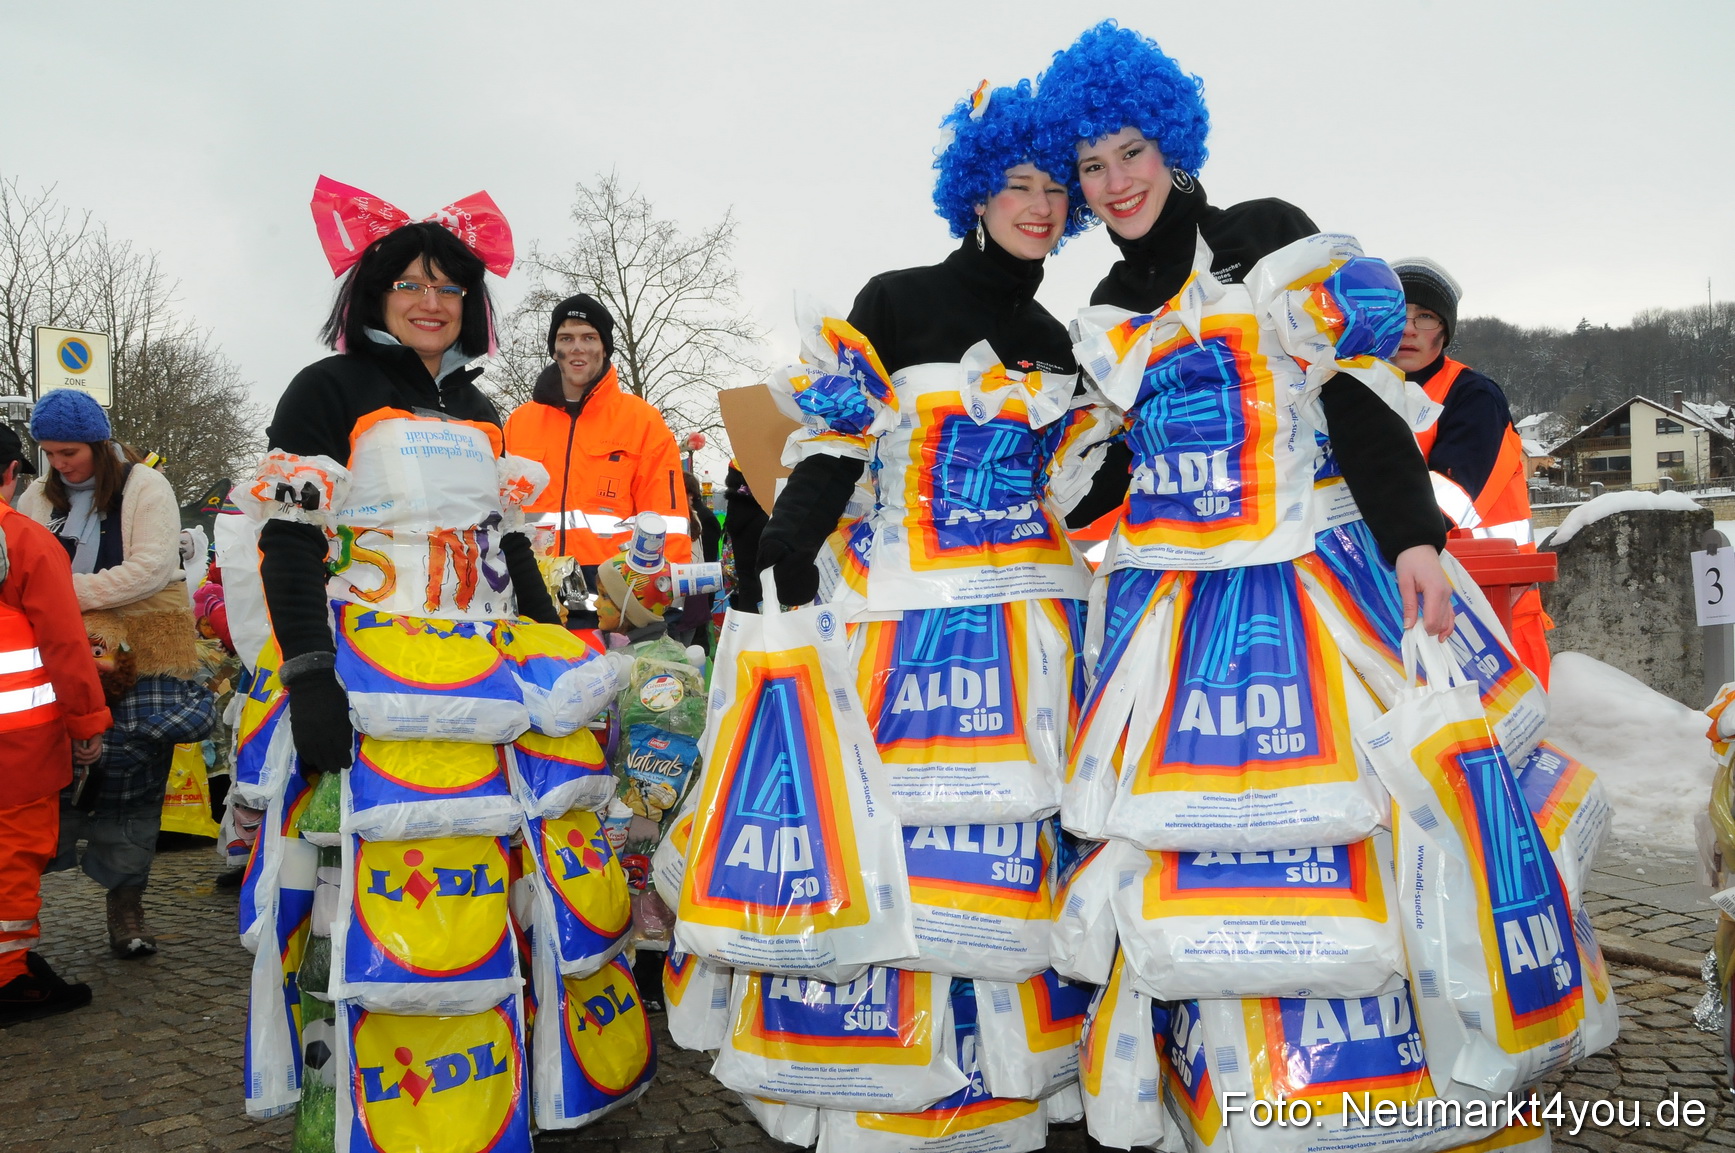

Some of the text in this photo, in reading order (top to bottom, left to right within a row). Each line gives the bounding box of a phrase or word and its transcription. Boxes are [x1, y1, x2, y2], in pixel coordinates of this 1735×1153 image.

[64, 378, 87, 387] ZONE
[404, 431, 473, 447] Fachgeschäft
[400, 445, 484, 463] Gut gekauft im
[1129, 450, 1229, 495] ALDI
[1193, 490, 1230, 517] SÜD
[1705, 567, 1723, 605] 3
[891, 666, 1001, 715] ALDI
[959, 707, 1004, 733] SÜD
[1177, 683, 1302, 736] ALDI
[1256, 728, 1306, 755] SÜD
[626, 748, 684, 778] Naturals
[853, 744, 875, 818] www.aldi-sued.de
[1165, 821, 1232, 830] Mehrzwecktragetasche
[1289, 815, 1320, 825] Gerauch!
[909, 822, 1037, 860] ALDI
[367, 849, 505, 910] LIDL
[991, 858, 1034, 885] SÜD
[1286, 862, 1338, 883] SÜD
[1414, 844, 1425, 930] www.aldi-sued.de
[931, 910, 961, 919] Gemeinsam
[980, 917, 1002, 925] Umwelt!
[915, 934, 953, 944] ecktragetasche
[968, 941, 1002, 950] wiederholten
[1002, 945, 1028, 953] Gebrauch!
[1316, 948, 1349, 956] ebrauch!
[844, 1004, 888, 1031] SÜD
[1300, 979, 1412, 1048] ALD
[1396, 1032, 1425, 1068] SÜ
[360, 1046, 508, 1108] LIDL
[1171, 1044, 1193, 1089] SÜD
[1307, 1141, 1376, 1153] Mehrzwecktragetasche
